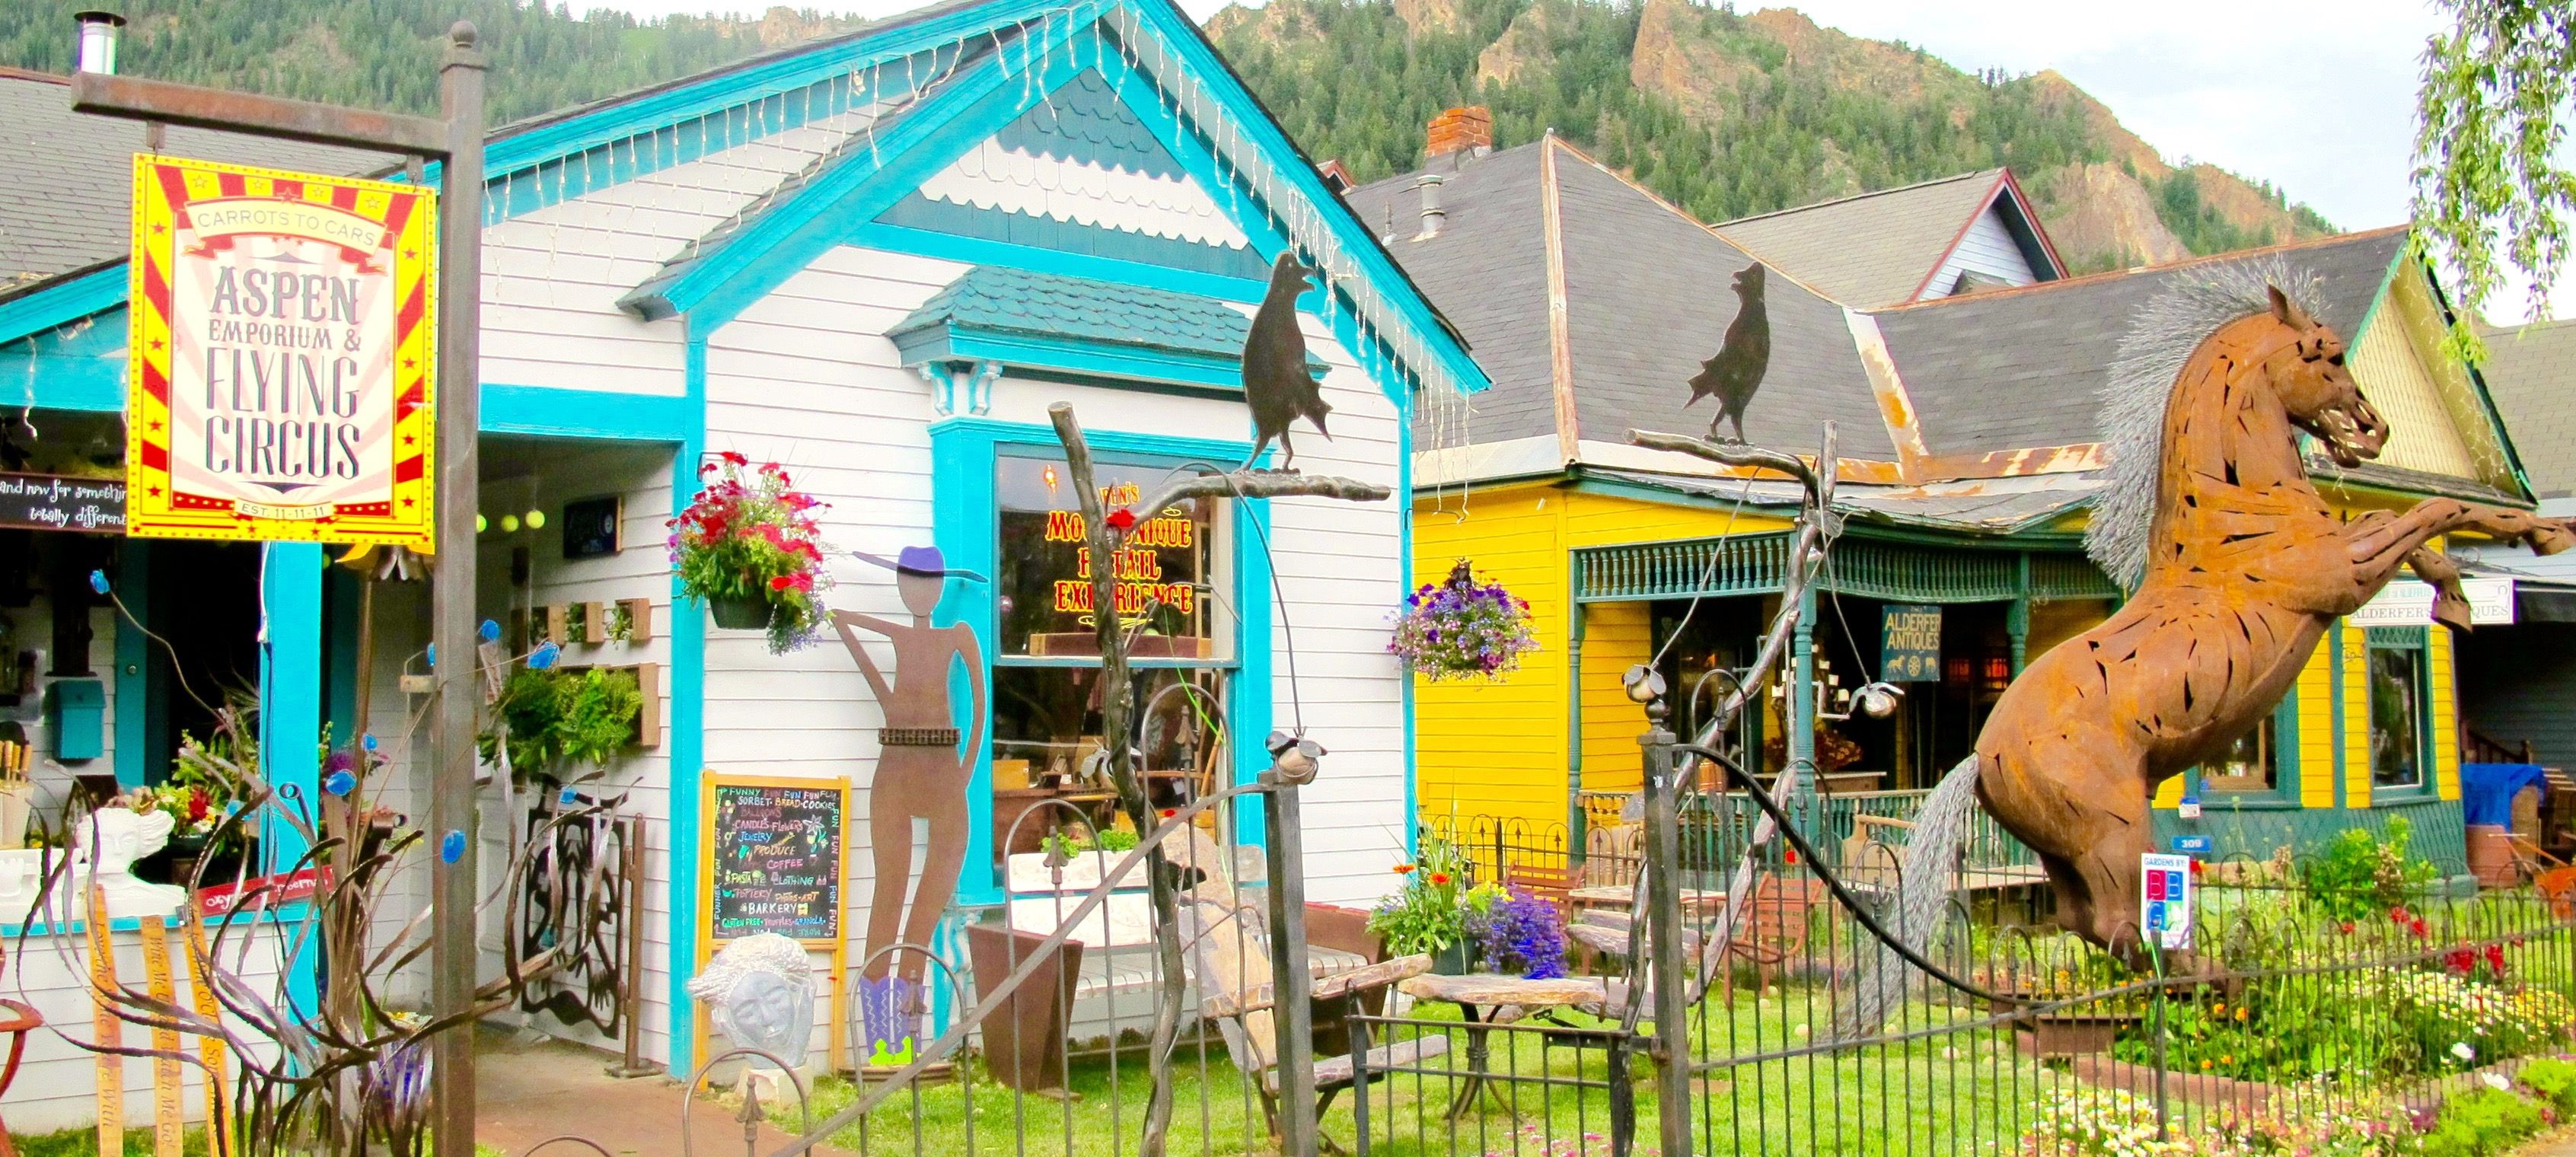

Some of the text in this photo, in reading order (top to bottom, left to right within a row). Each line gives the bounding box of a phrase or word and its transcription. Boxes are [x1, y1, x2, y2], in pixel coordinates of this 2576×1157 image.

[198, 210, 375, 247] CARROTS TO CARS
[209, 265, 360, 325] ASPEN
[208, 318, 361, 352] EMPORIUM &
[206, 346, 360, 419] FLYING
[206, 416, 360, 480] CIRCUS
[0, 479, 24, 494] and
[27, 485, 50, 496] now
[49, 479, 72, 502] for
[30, 507, 70, 528] totally
[241, 503, 324, 519] EST. 11-11-11
[1885, 613, 1942, 632] ALDERFER
[1886, 632, 1940, 650] ANTIQUES
[729, 789, 761, 797] FUNNY
[784, 790, 802, 798] FUN
[803, 792, 820, 800] FUN
[831, 835, 839, 854] FUN
[767, 859, 804, 869] COFFEE
[2144, 857, 2174, 866] GARDENS
[829, 885, 837, 904] FUN
[749, 902, 797, 914] BARKERY
[828, 909, 837, 930] FUN
[149, 936, 165, 967] Wine
